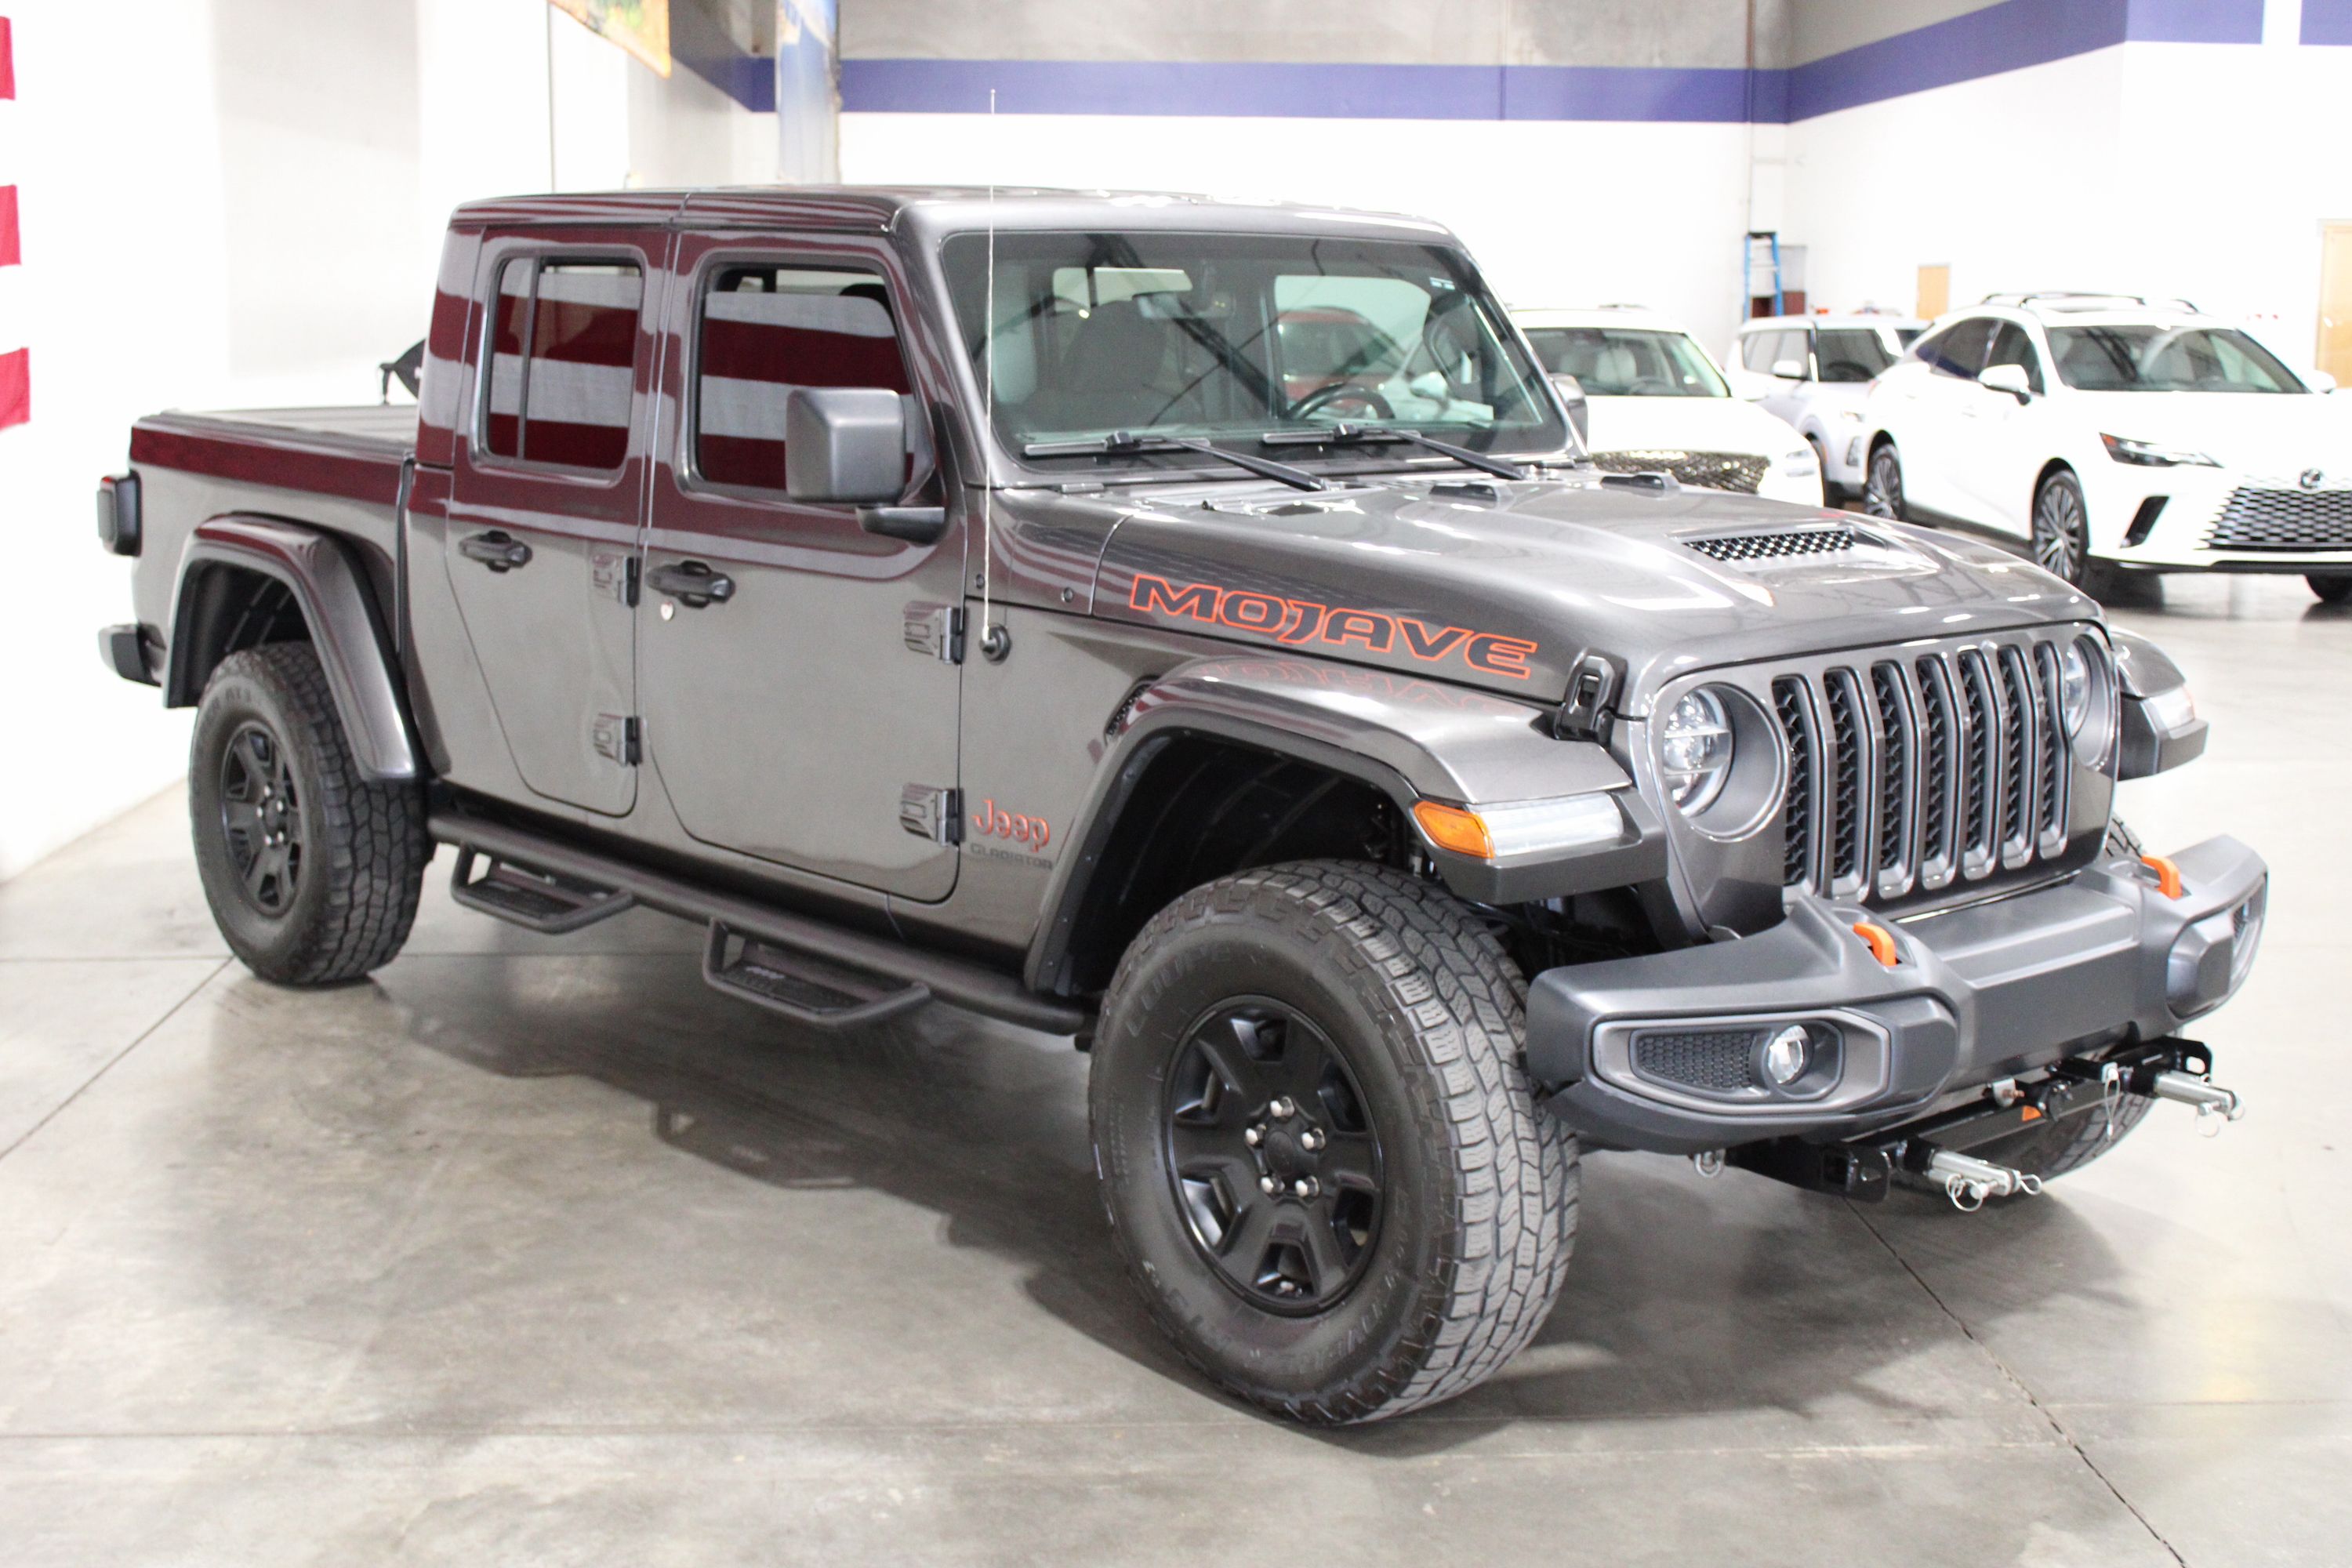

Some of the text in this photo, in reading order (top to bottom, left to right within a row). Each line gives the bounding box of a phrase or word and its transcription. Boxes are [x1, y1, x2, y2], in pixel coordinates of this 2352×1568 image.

[1129, 574, 1538, 680] MOJAVE
[971, 798, 1051, 854] Jeep
[971, 843, 1053, 870] GLADIATOR
